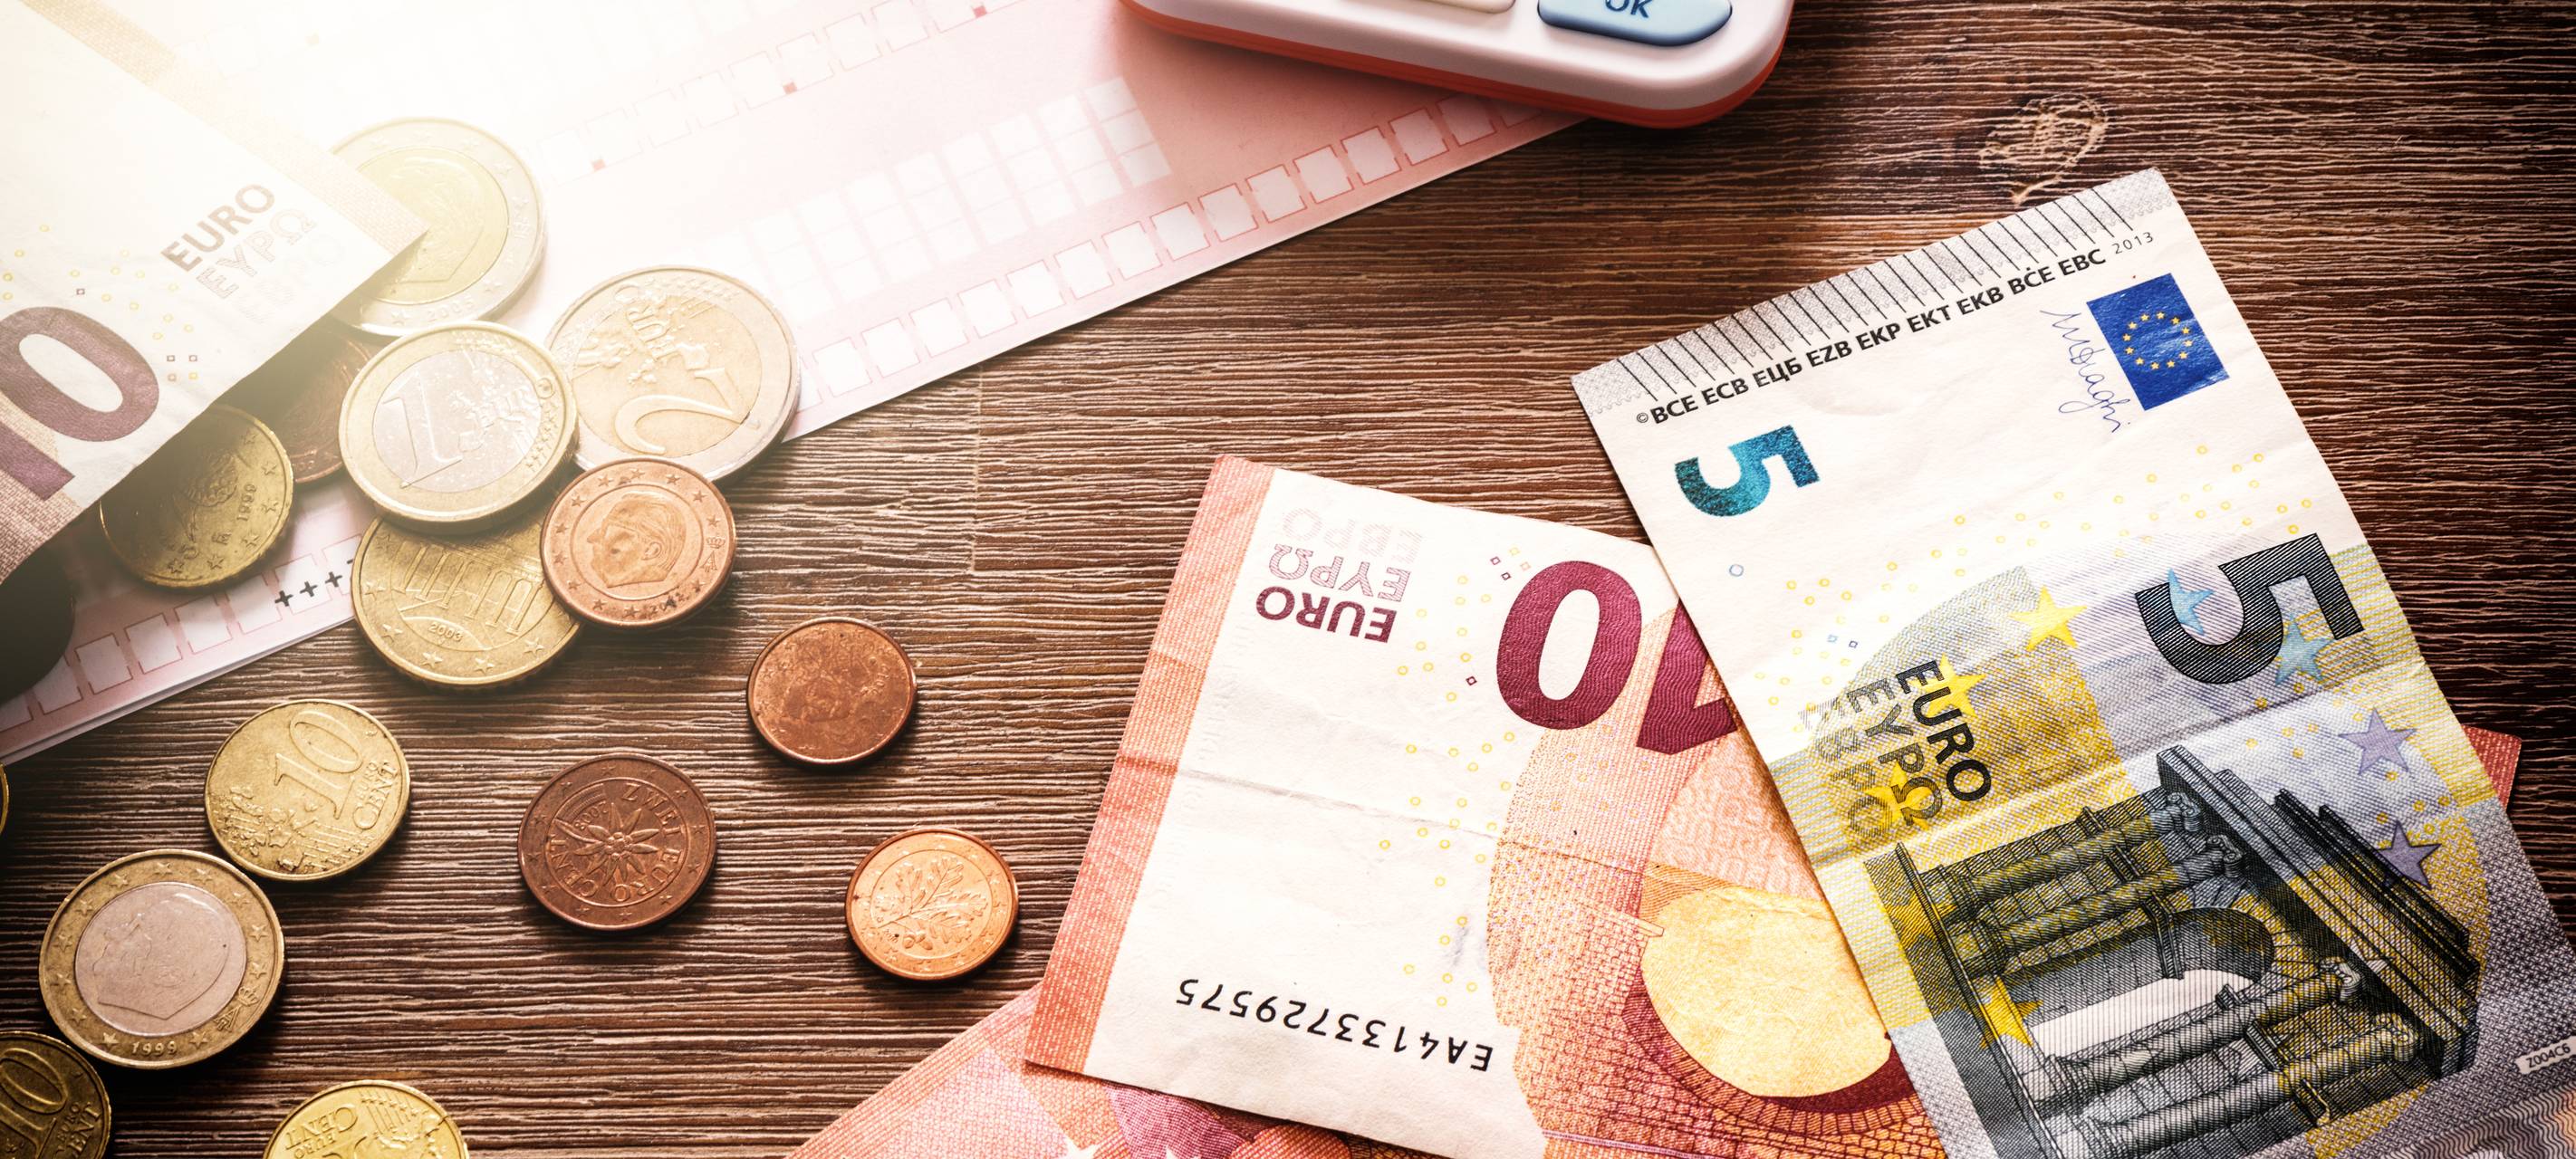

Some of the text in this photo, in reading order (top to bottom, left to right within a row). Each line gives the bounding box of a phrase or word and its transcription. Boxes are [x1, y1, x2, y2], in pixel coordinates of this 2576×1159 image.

[1605, 0, 1652, 18] OK
[160, 184, 275, 273] EURO
[1806, 340, 1852, 368] EZB
[1856, 322, 1901, 350] EKP
[1907, 304, 1952, 332] EKT
[1956, 286, 2004, 315] EKB
[2058, 248, 2106, 276] EBC
[2111, 232, 2154, 254] 2013
[1674, 425, 1821, 518] 5
[428, 620, 464, 642] 2003
[1256, 586, 1398, 643] EURO
[2134, 532, 2366, 685] 5
[1496, 560, 1739, 755] 10
[274, 710, 363, 820] 10
[1896, 660, 1992, 801] EURO
[351, 761, 399, 829] CENT
[547, 782, 686, 903] ZWEI EURO CENT
[131, 1040, 178, 1056] 1999
[1176, 979, 1494, 1072] EA4133729575
[2525, 1042, 2571, 1068] Z004C6
[285, 1106, 360, 1152] CENT
